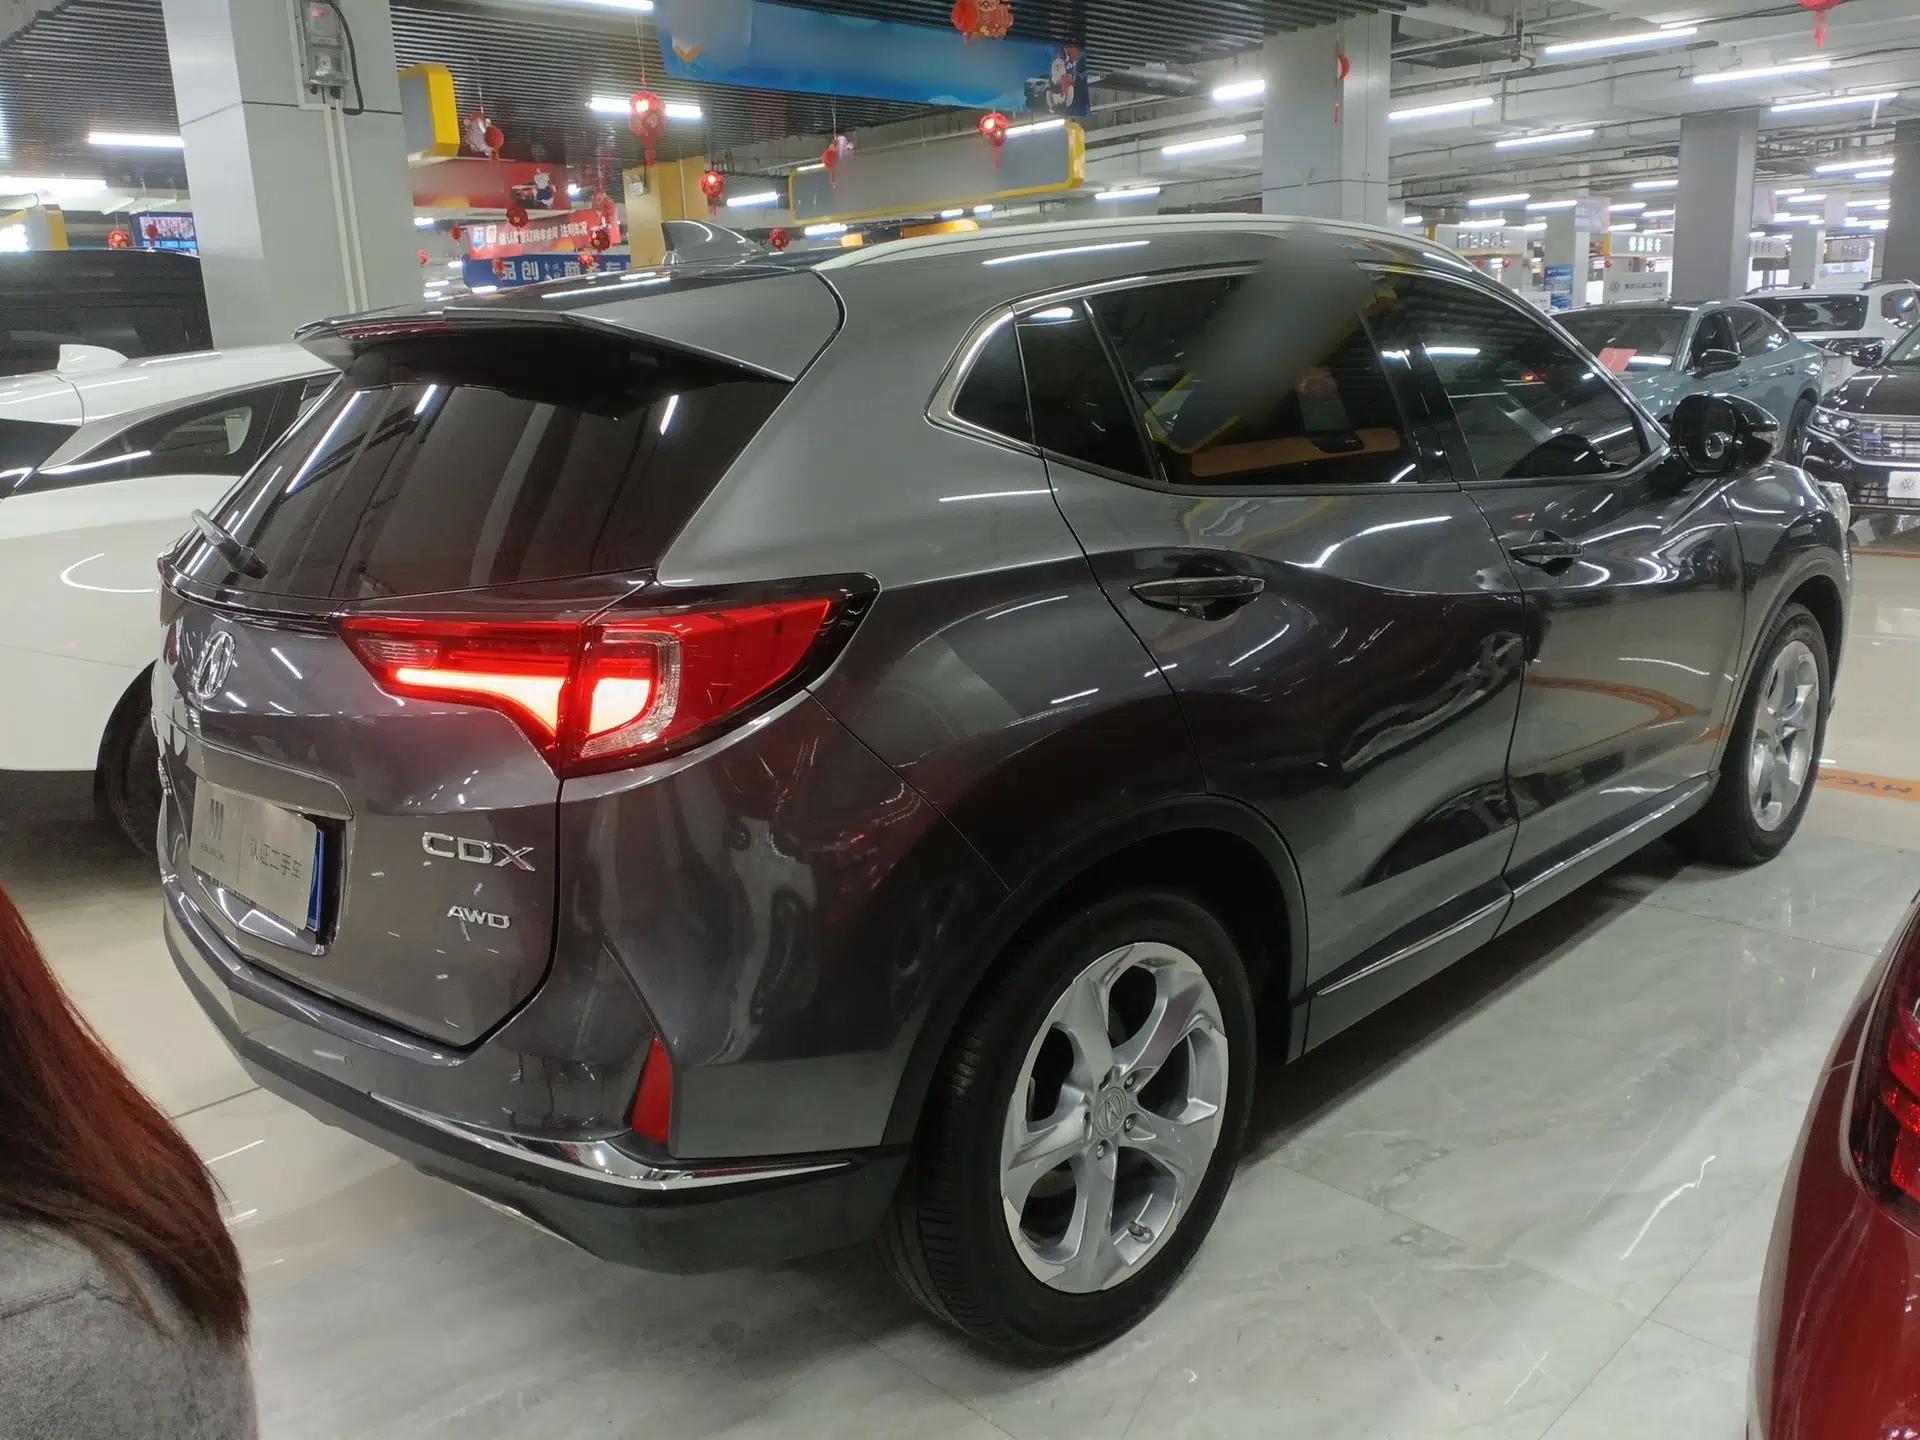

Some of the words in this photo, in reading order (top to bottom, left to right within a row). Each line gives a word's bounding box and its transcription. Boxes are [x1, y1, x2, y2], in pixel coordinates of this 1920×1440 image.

[249, 836, 303, 880] 认证二手车
[421, 831, 536, 872] CDX
[446, 905, 512, 929] AWD
